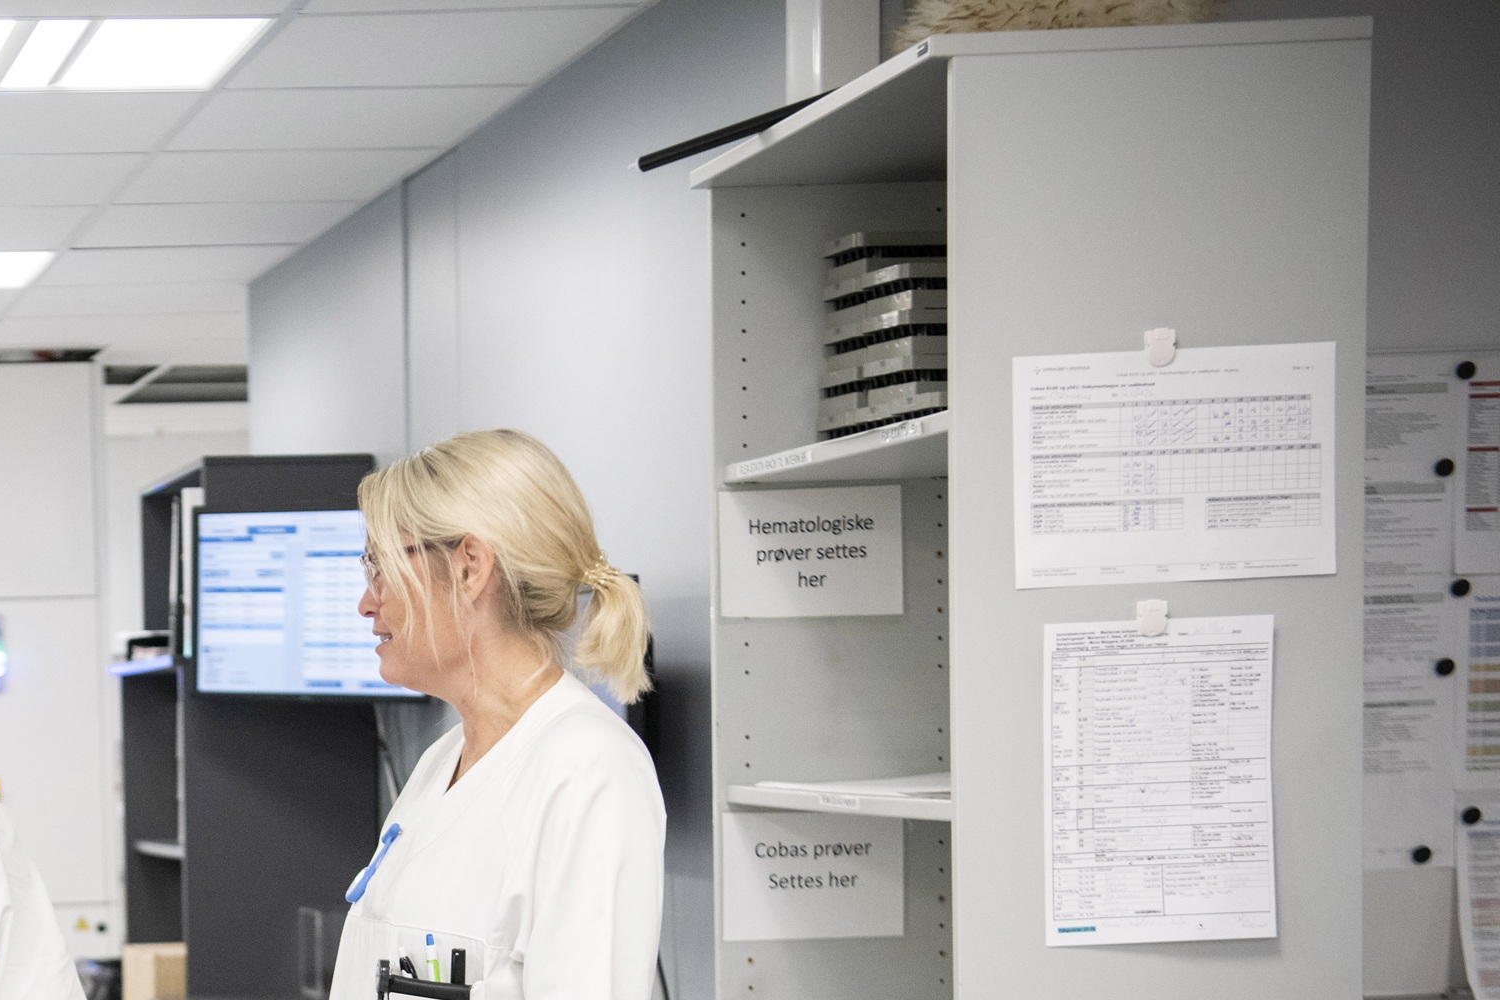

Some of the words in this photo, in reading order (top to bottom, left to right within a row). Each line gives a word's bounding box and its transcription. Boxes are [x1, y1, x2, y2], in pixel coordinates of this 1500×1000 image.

[749, 514, 874, 536] Hematologiske
[757, 547, 812, 565] prøver
[816, 544, 867, 560] settes
[798, 571, 827, 588] her
[755, 841, 808, 859] Cobas
[813, 842, 872, 860] prøver
[769, 873, 823, 889] Settes
[828, 871, 858, 888] her
